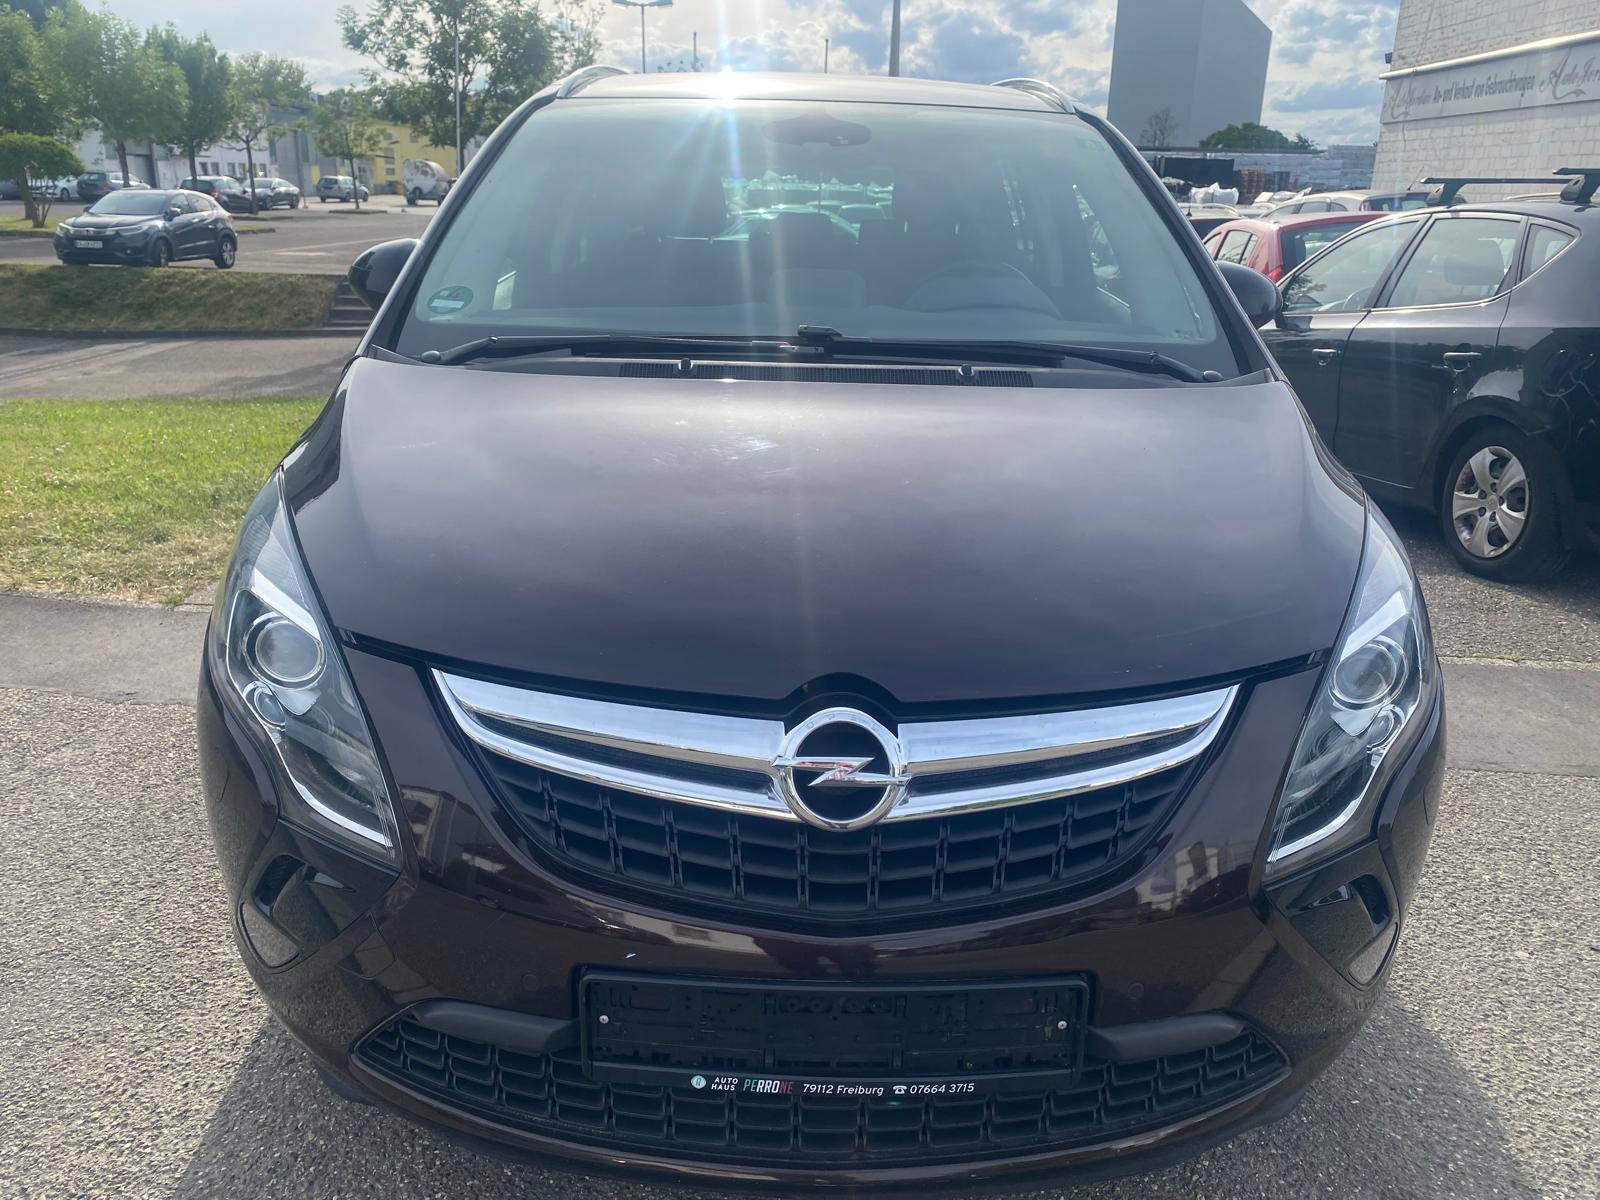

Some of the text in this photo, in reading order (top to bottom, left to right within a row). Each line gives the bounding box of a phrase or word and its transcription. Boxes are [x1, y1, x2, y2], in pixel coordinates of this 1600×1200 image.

[714, 1077, 739, 1085] AUTO
[743, 1079, 975, 1096] PERRONE 79112 Freiburg 07664 3715
